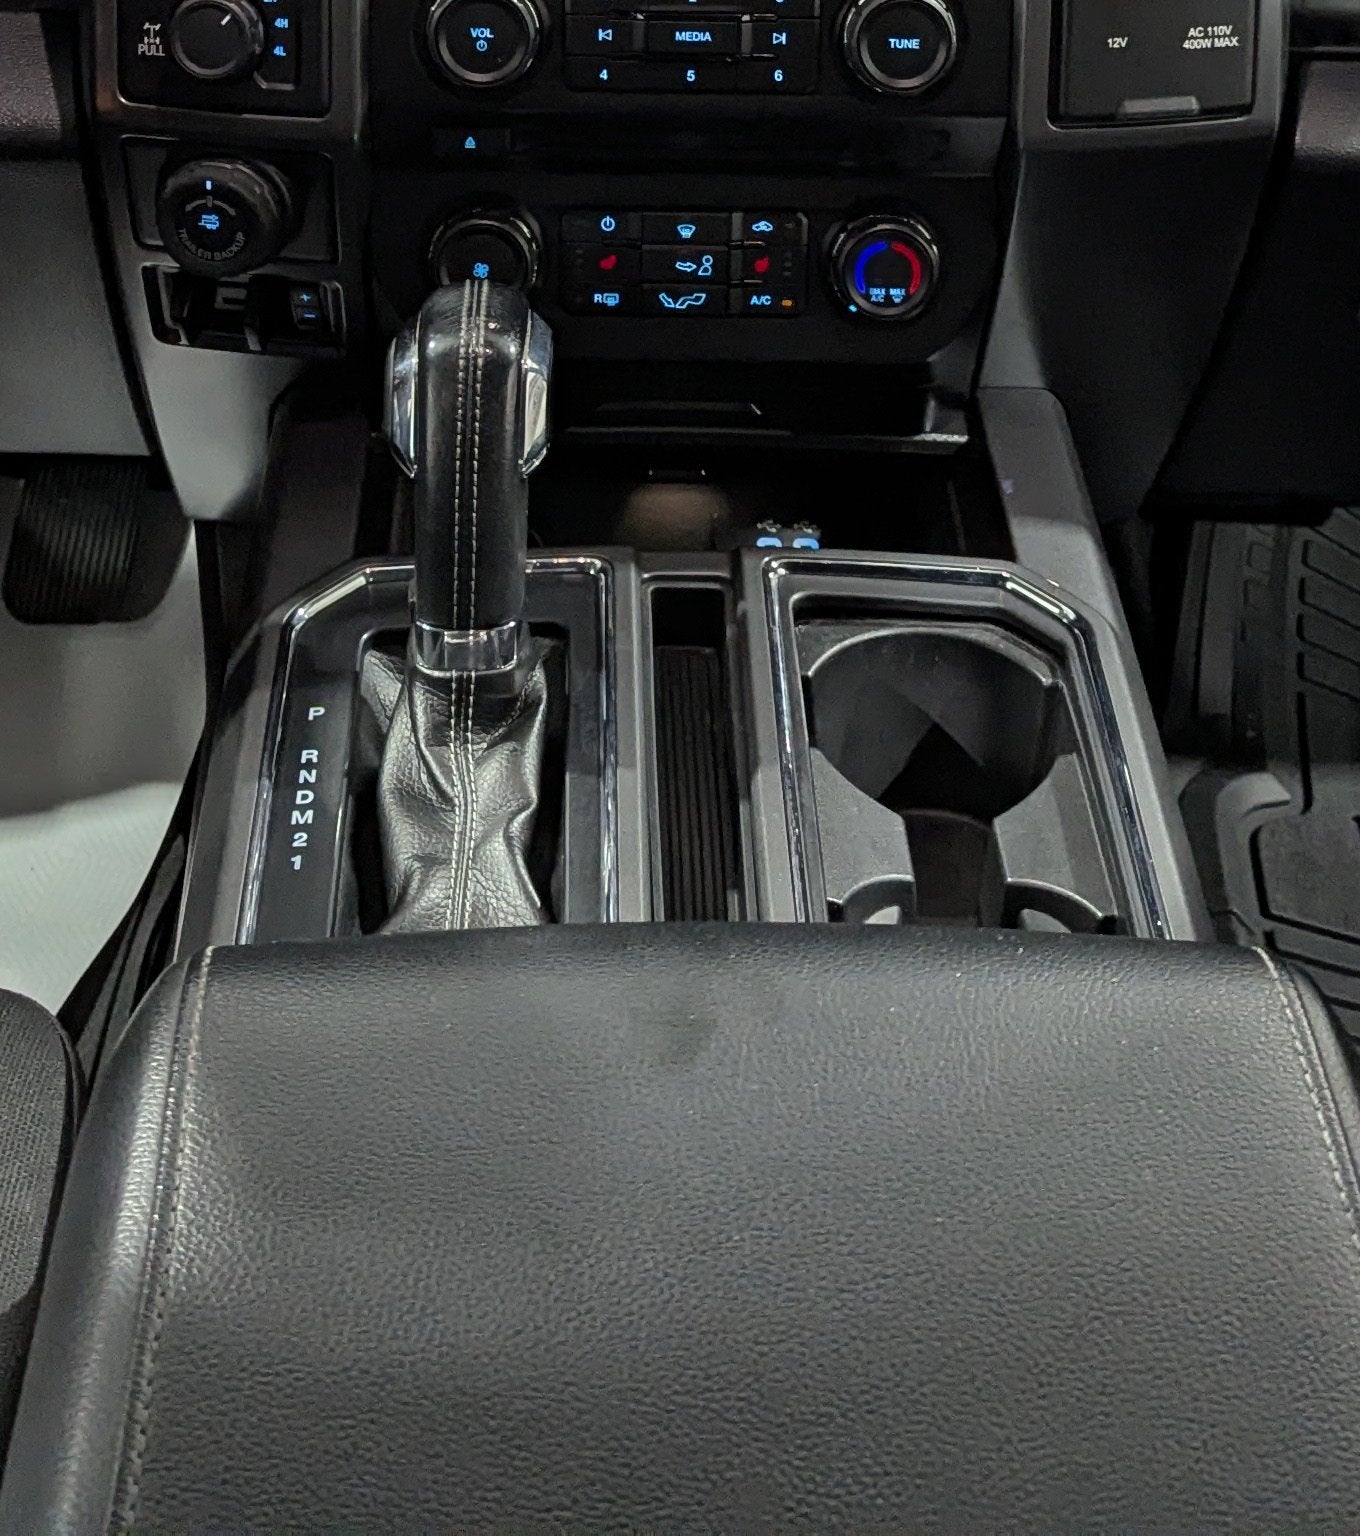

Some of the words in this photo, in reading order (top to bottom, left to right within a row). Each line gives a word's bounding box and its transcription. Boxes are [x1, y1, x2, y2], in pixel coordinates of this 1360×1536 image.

[470, 27, 494, 39] VOL
[675, 31, 712, 42] MEDIA
[1188, 26, 1205, 38] AC
[1206, 25, 1233, 37] 110V
[888, 38, 920, 50] TUNE
[1107, 37, 1128, 48] 12V
[1182, 38, 1213, 50] 400W
[1214, 36, 1239, 48] MAX
[138, 43, 165, 56] PULL
[599, 69, 608, 80] 4
[686, 70, 695, 82] 5
[774, 70, 783, 82] 6
[750, 295, 772, 306] A/C
[308, 707, 325, 721] P
[300, 749, 318, 764] R
[298, 769, 317, 784] N
[295, 790, 315, 805] D
[291, 809, 314, 825] M
[292, 832, 308, 847] 2
[291, 855, 302, 870] 1
